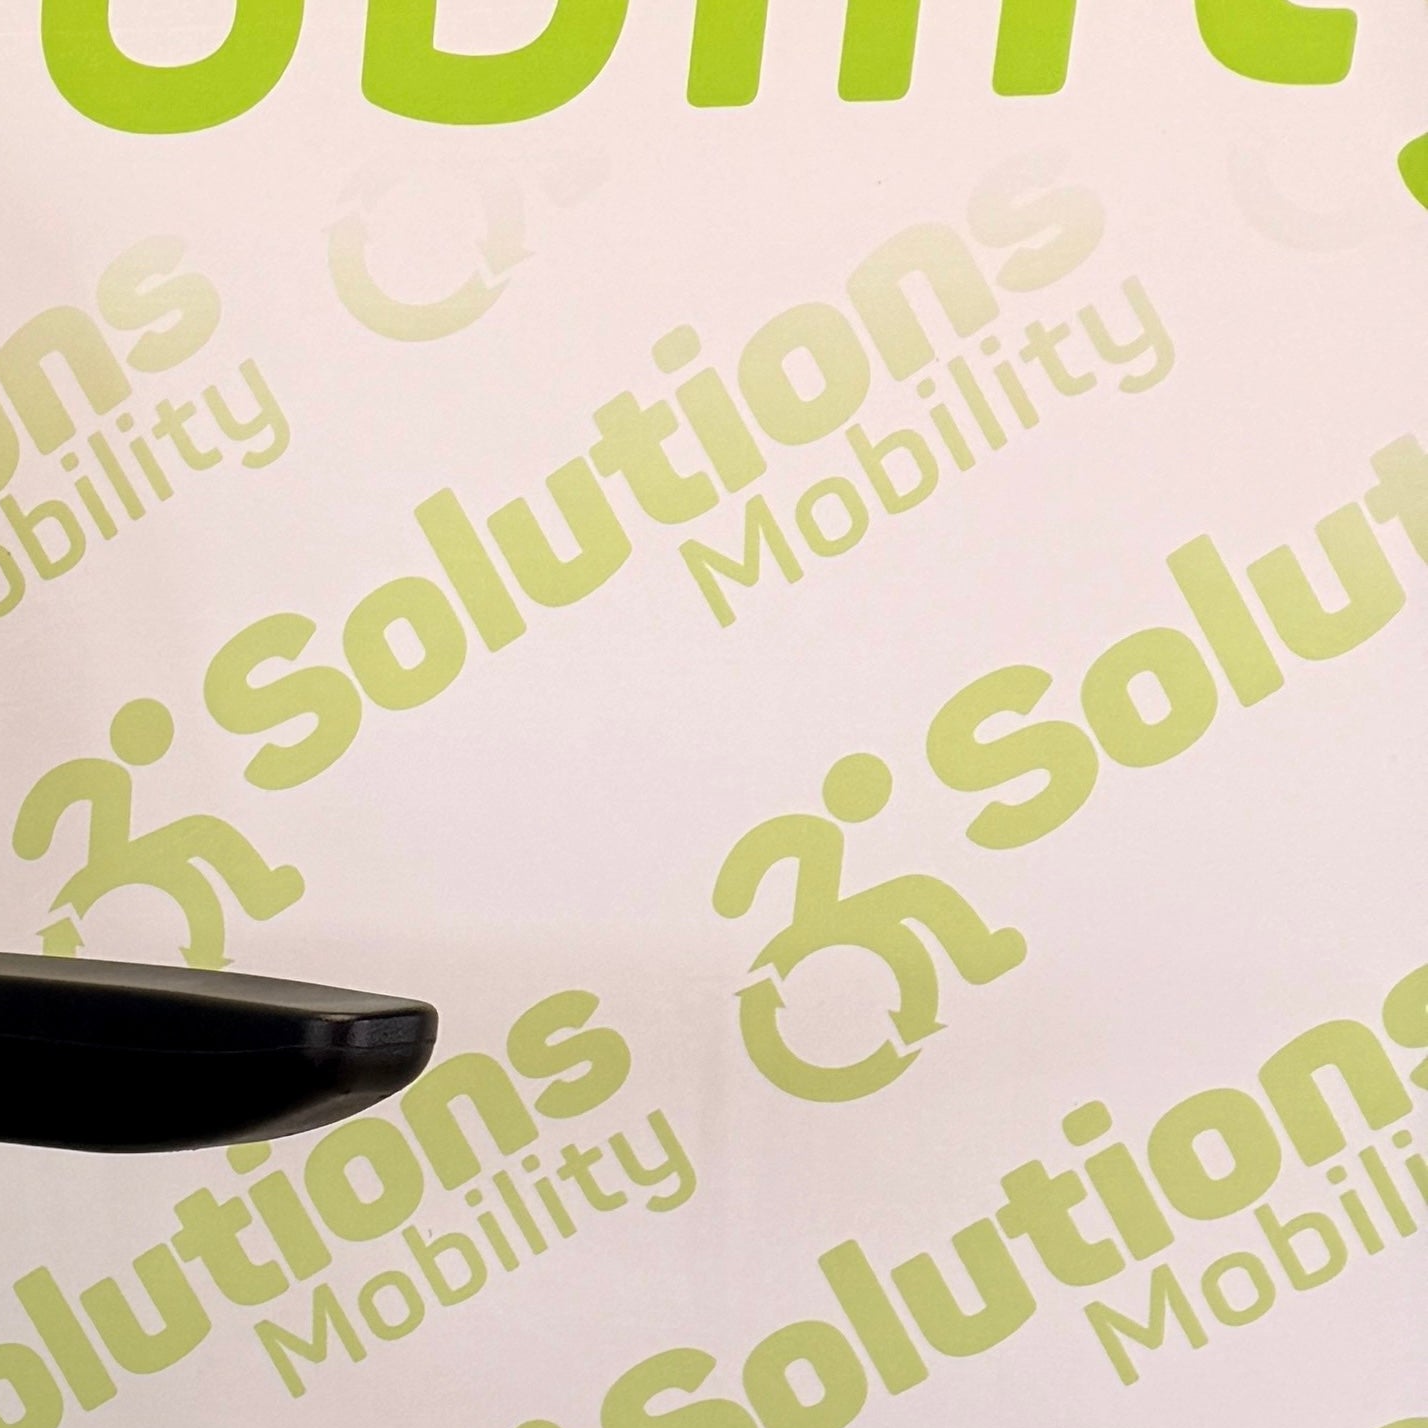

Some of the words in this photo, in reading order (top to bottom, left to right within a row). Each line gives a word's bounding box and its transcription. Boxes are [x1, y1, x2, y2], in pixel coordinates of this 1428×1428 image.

[205, 158, 1104, 789] Solutions
[681, 274, 1169, 625] Mobility
[256, 1112, 695, 1396] Mobility
